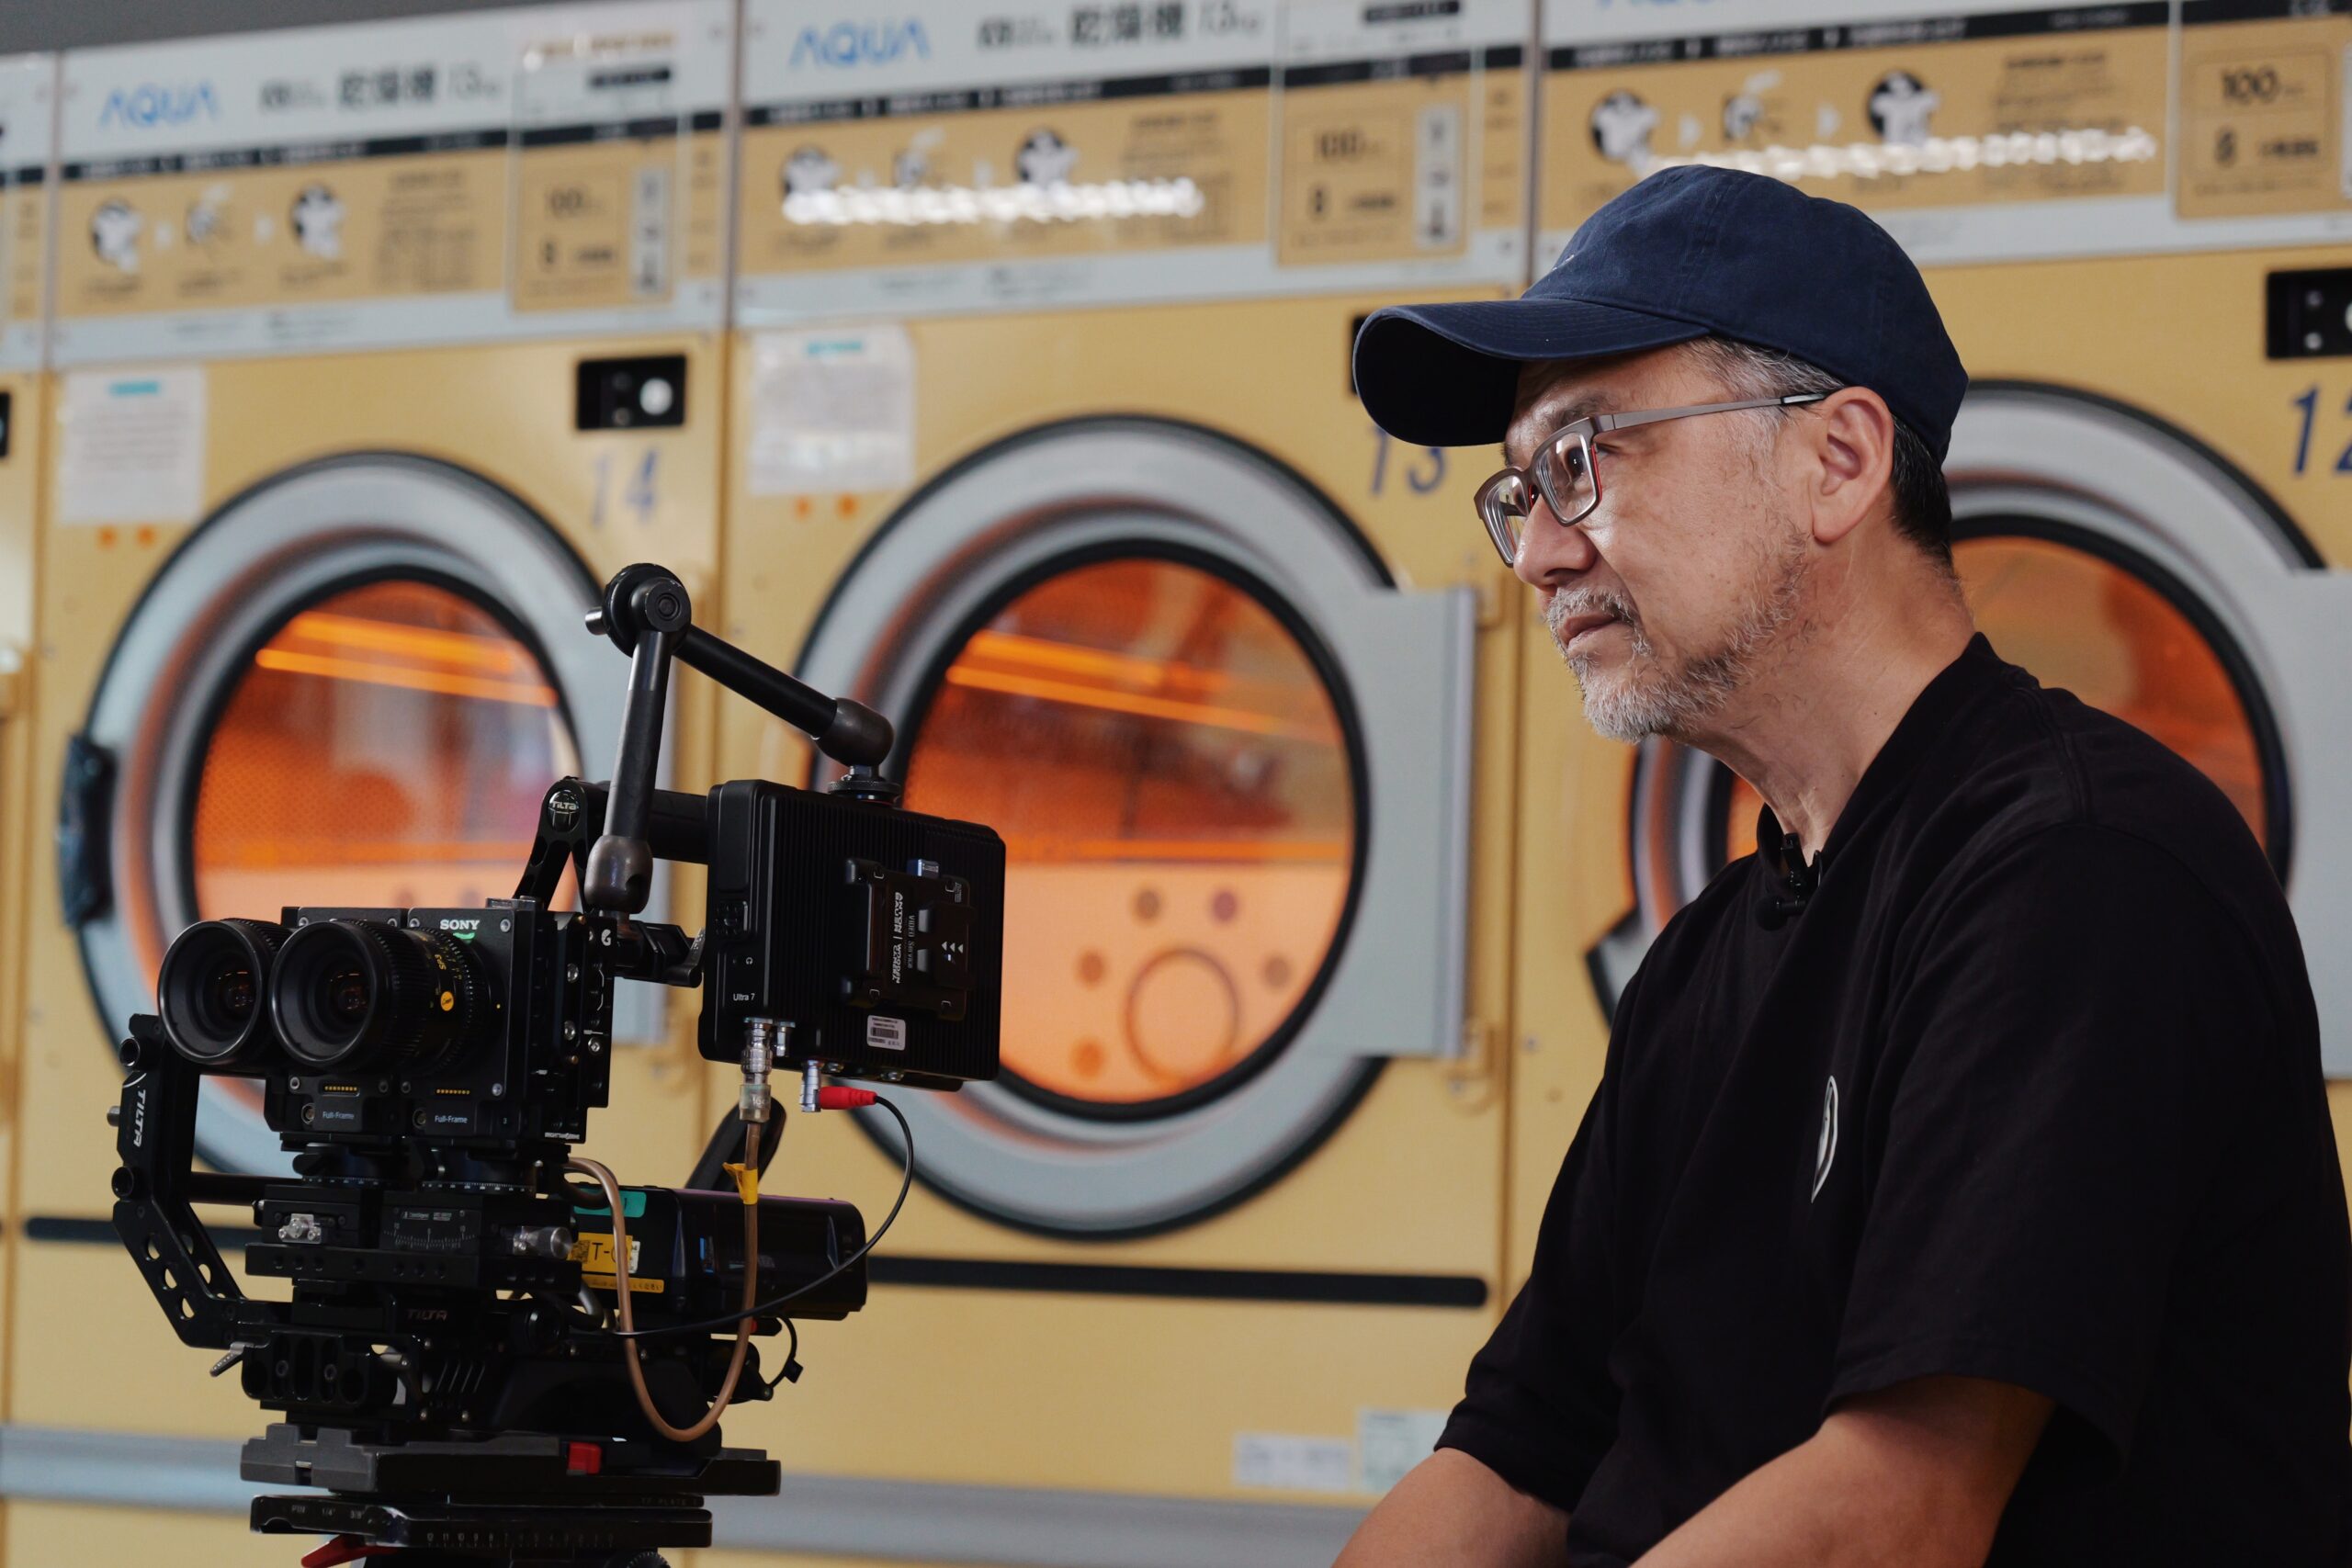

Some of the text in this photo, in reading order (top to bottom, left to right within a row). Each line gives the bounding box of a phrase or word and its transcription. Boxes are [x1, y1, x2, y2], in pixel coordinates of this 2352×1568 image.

[790, 19, 932, 68] AQUA
[100, 83, 221, 128] AQUA
[439, 919, 480, 930] SONY
[732, 993, 749, 1001] Ultra
[133, 1089, 146, 1148] TILTA
[322, 1111, 355, 1120] Full-Frame
[435, 1114, 469, 1123] Full-Frame
[405, 1309, 448, 1321] TILTA
